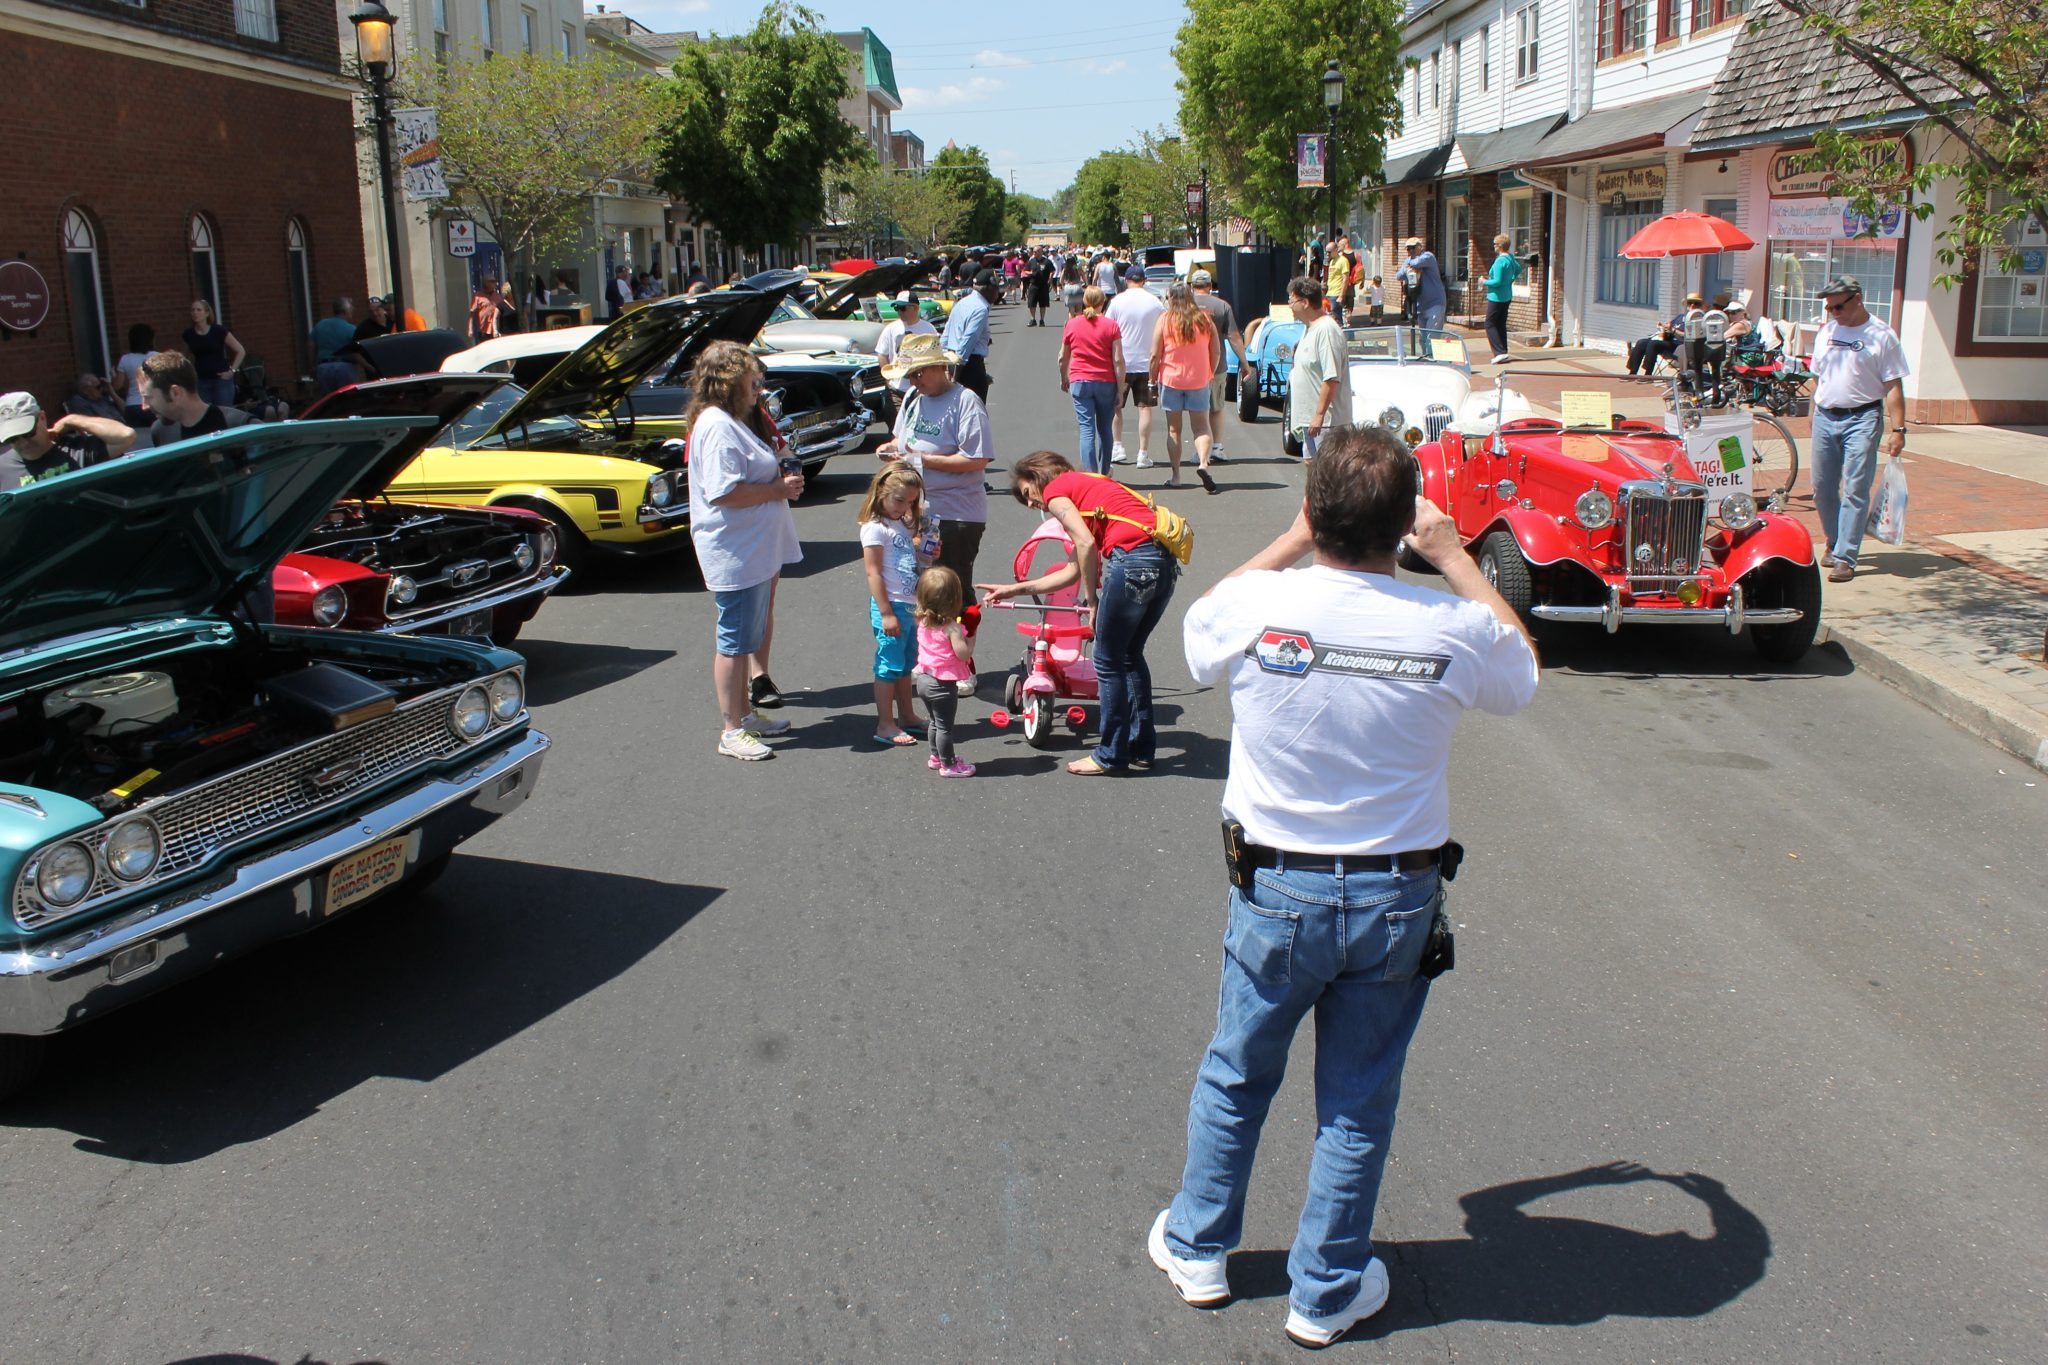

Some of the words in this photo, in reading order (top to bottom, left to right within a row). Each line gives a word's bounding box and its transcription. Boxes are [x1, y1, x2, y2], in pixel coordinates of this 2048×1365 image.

[454, 245, 473, 253] ATM
[1695, 460, 1720, 474] TAG!
[1730, 472, 1743, 485] It.
[1321, 651, 1399, 672] Raceway
[1396, 659, 1438, 675] Park
[332, 864, 355, 888] ONE
[356, 844, 402, 875] NATION
[332, 874, 370, 904] UNDER
[372, 862, 397, 884] GOD
